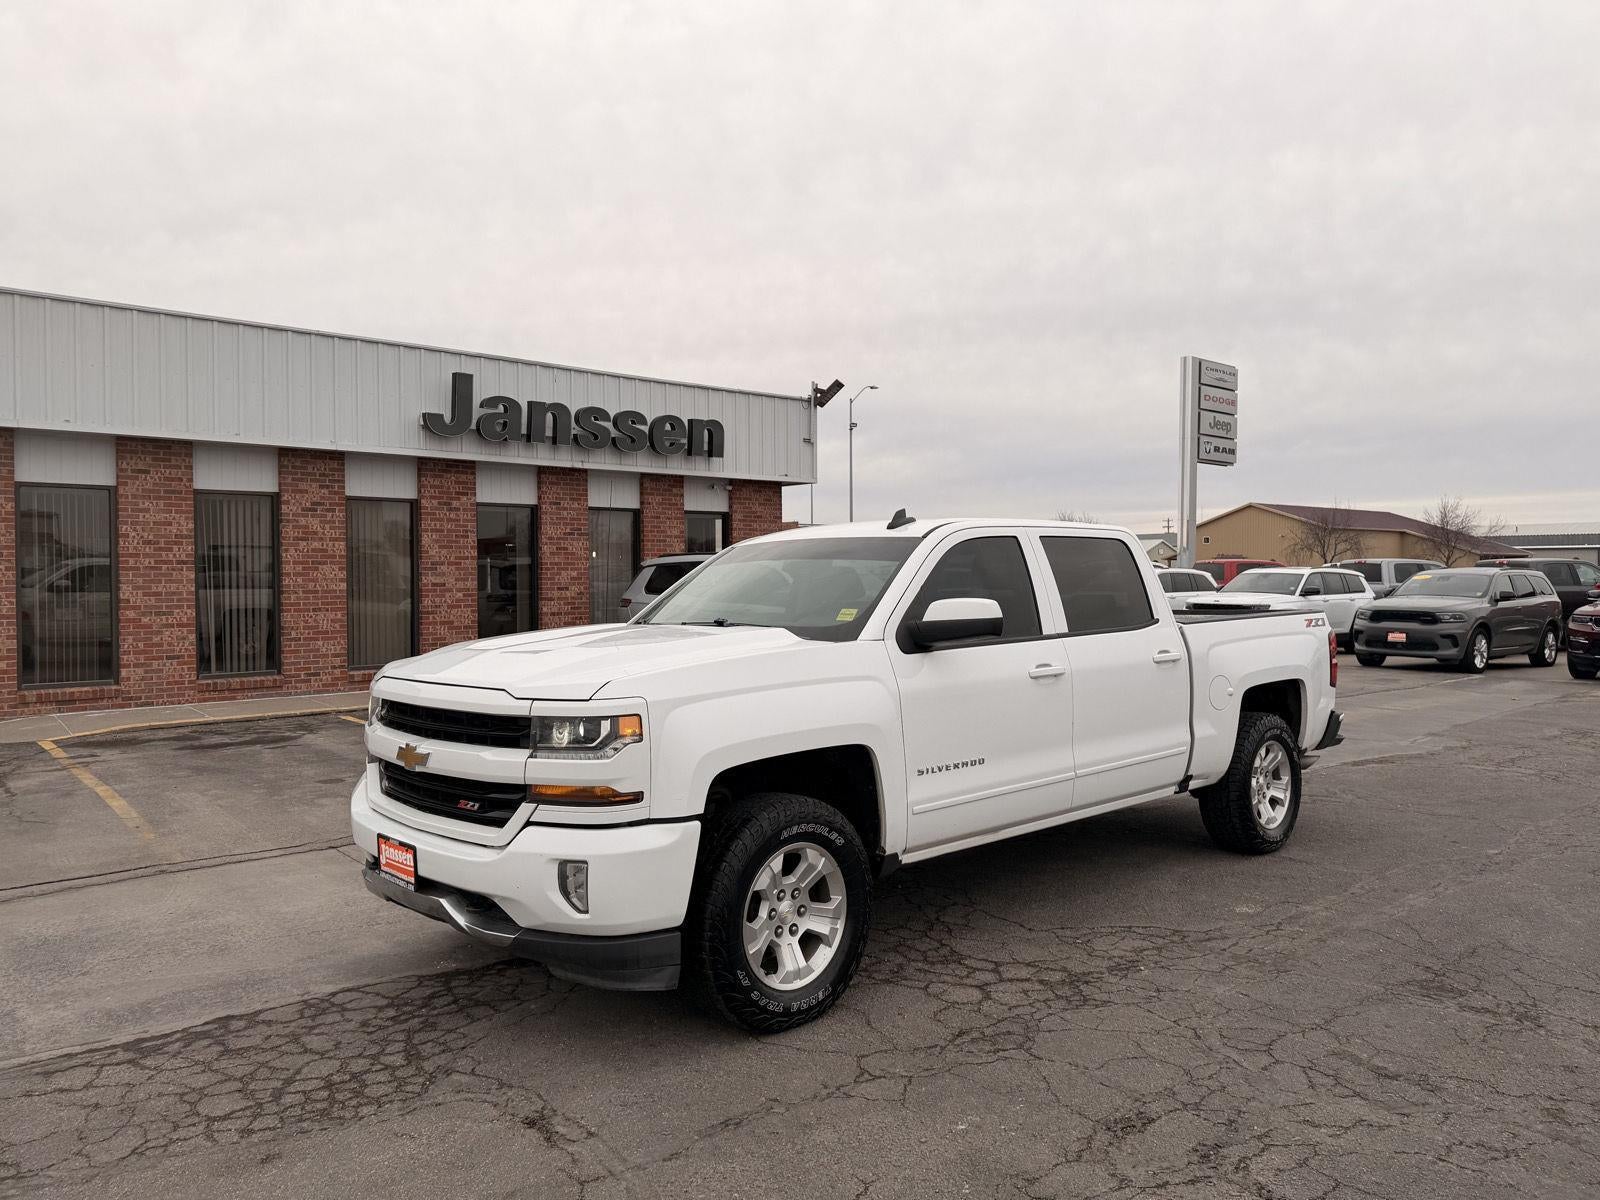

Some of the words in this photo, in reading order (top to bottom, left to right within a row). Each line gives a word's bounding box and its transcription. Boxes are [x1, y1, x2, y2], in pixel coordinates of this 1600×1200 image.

[1205, 366, 1236, 377] CHRYSLER
[1203, 394, 1236, 407] DODGE
[421, 371, 725, 458] Janssen
[1208, 415, 1232, 435] Jeep
[1213, 445, 1236, 456] RAM
[917, 757, 985, 776] SILVERADO
[780, 823, 845, 846] HERCULES
[380, 843, 415, 866] Janssen
[750, 990, 784, 1013] TRAC
[790, 983, 832, 1012] TERRA
